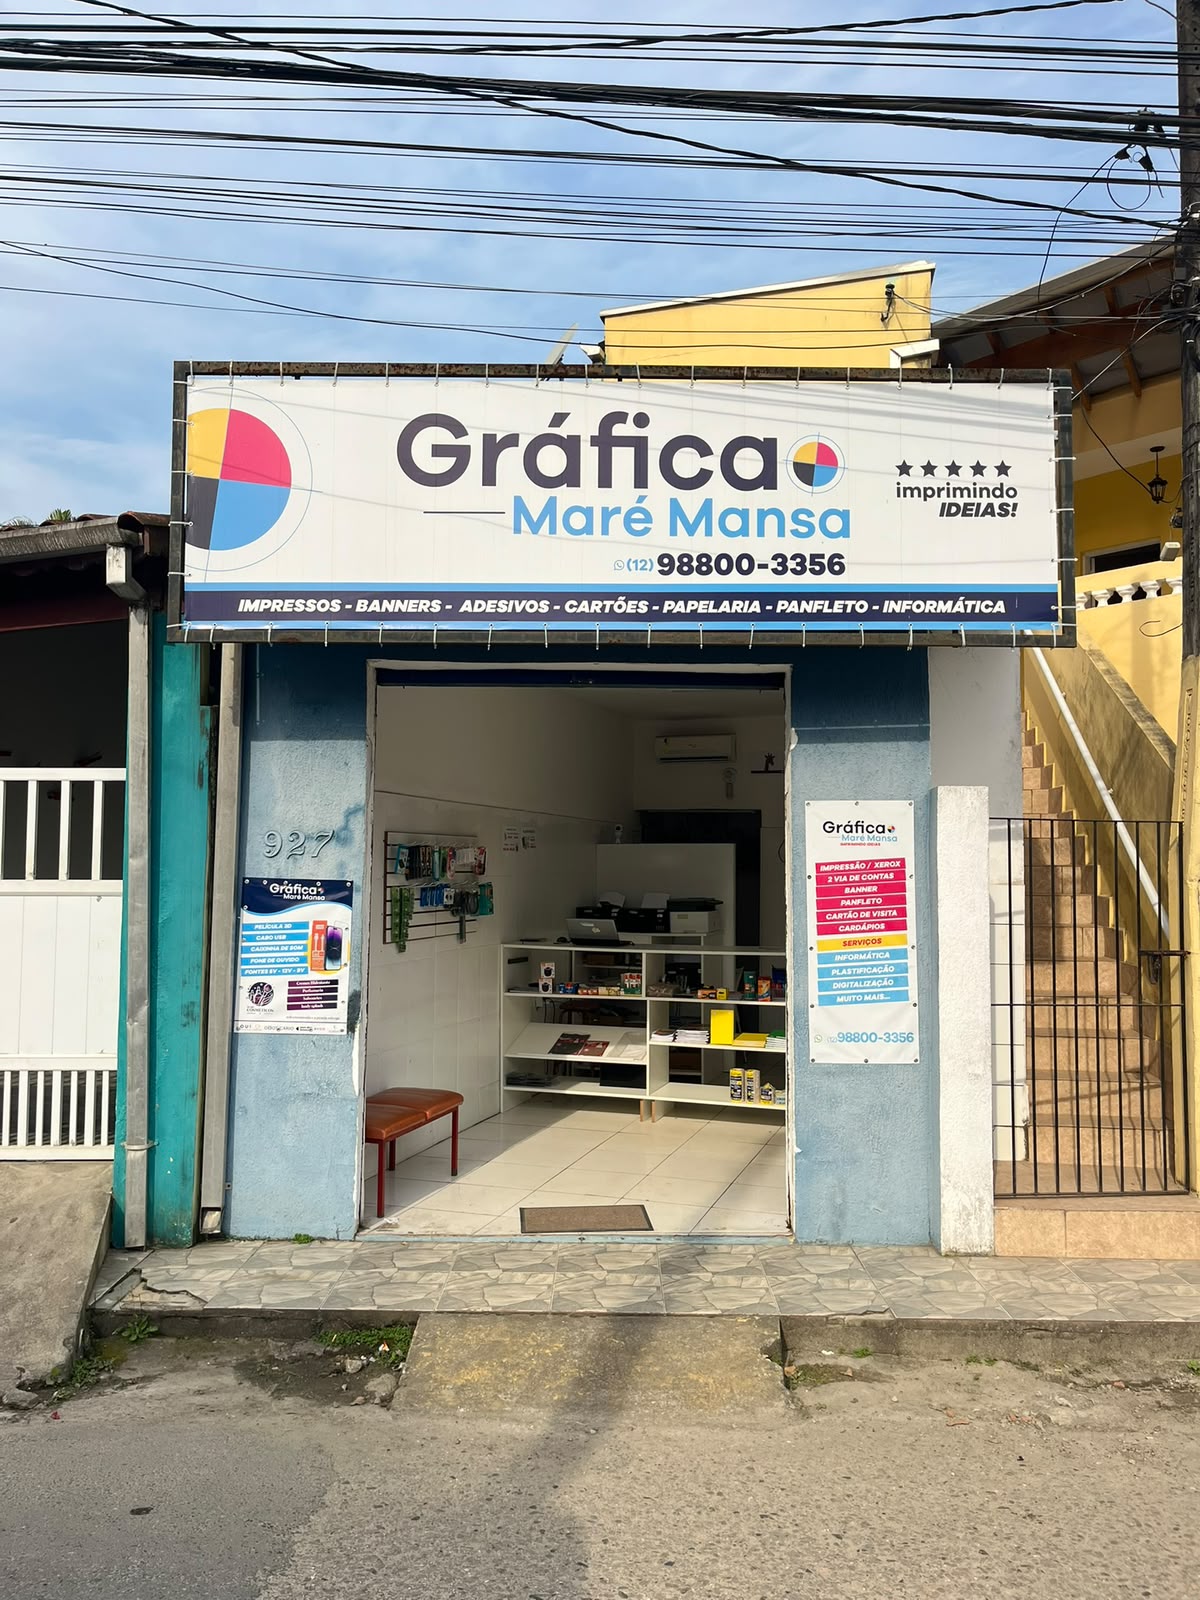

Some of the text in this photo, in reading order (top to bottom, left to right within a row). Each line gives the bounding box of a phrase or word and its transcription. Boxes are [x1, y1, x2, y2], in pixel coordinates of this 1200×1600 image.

[396, 411, 779, 491] Gráfica
[896, 482, 1018, 502] imprimindo
[938, 502, 1018, 519] IDEIAS!
[513, 495, 851, 539] Maré Mansa
[626, 552, 846, 577] (12) 98800-3356
[237, 599, 342, 613] IMPRESSOS
[355, 599, 442, 613] BANNERS
[459, 600, 551, 613] ADESIVOS
[564, 596, 649, 614] CARTÕES
[662, 600, 762, 614] PAPELARIA
[775, 600, 869, 614] PANFLETO
[882, 596, 1007, 614] INFORMÁTICA
[823, 820, 886, 834] Gráfica
[841, 834, 898, 842] Maré Mansa
[262, 829, 335, 860] 927
[820, 861, 866, 872] IMPRESSÃO
[874, 860, 901, 869] XEROX
[861, 872, 895, 881] CONTAS
[269, 883, 318, 895] Gráfica
[844, 885, 878, 894] BANNER
[840, 898, 882, 906] PANFLETO
[825, 911, 859, 920] CARTÃO
[872, 910, 897, 918] VISITA
[838, 923, 885, 932] CARDÁPIOS
[842, 937, 882, 947] SERVIÇOS
[834, 952, 890, 961] INFORMÁTICA
[831, 965, 895, 976] PLASTIFICAÇÃO
[832, 978, 894, 989] DIGITALIZAÇÃO
[836, 995, 862, 1003] MUITO
[837, 1031, 915, 1043] 98800-3356
